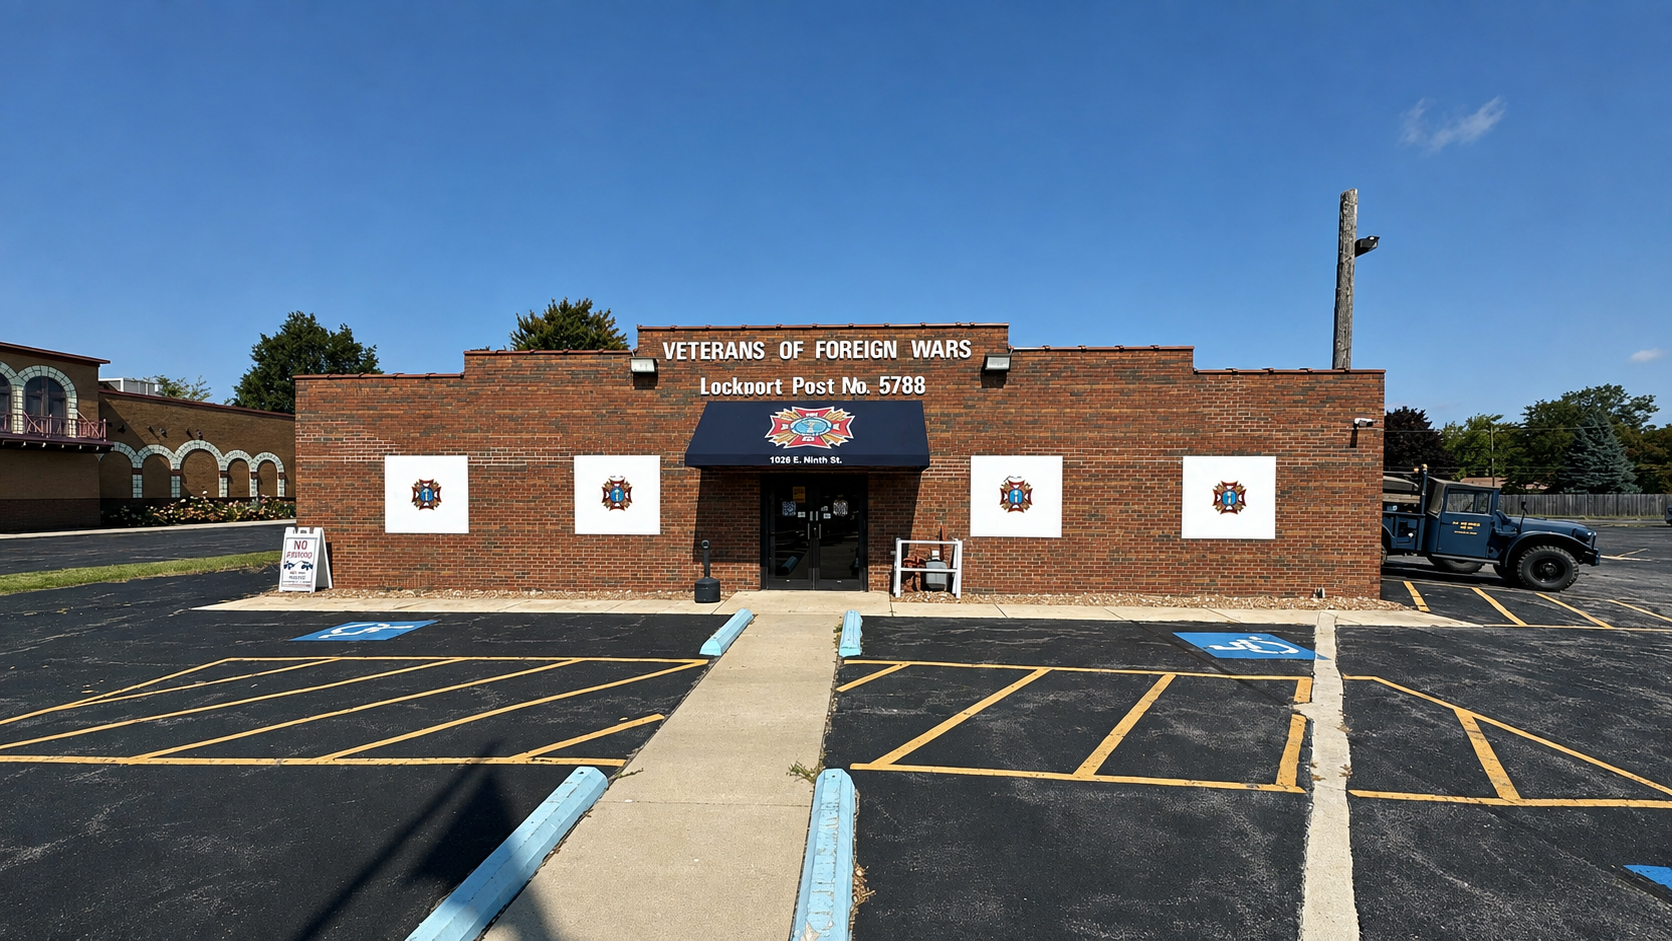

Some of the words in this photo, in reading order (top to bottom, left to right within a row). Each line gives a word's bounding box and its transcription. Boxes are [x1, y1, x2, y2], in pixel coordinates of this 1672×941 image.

[662, 341, 765, 360] VETERANS
[779, 341, 804, 360] OF
[815, 340, 897, 359] FOREIGN
[911, 339, 972, 359] WARS
[700, 377, 783, 397] Lockport
[792, 377, 835, 395] Post
[842, 376, 871, 395] No.
[879, 376, 926, 395] 5788
[793, 456, 802, 464] E.
[803, 456, 828, 464] Ninth
[830, 456, 842, 464] St.
[293, 540, 308, 550] NO
